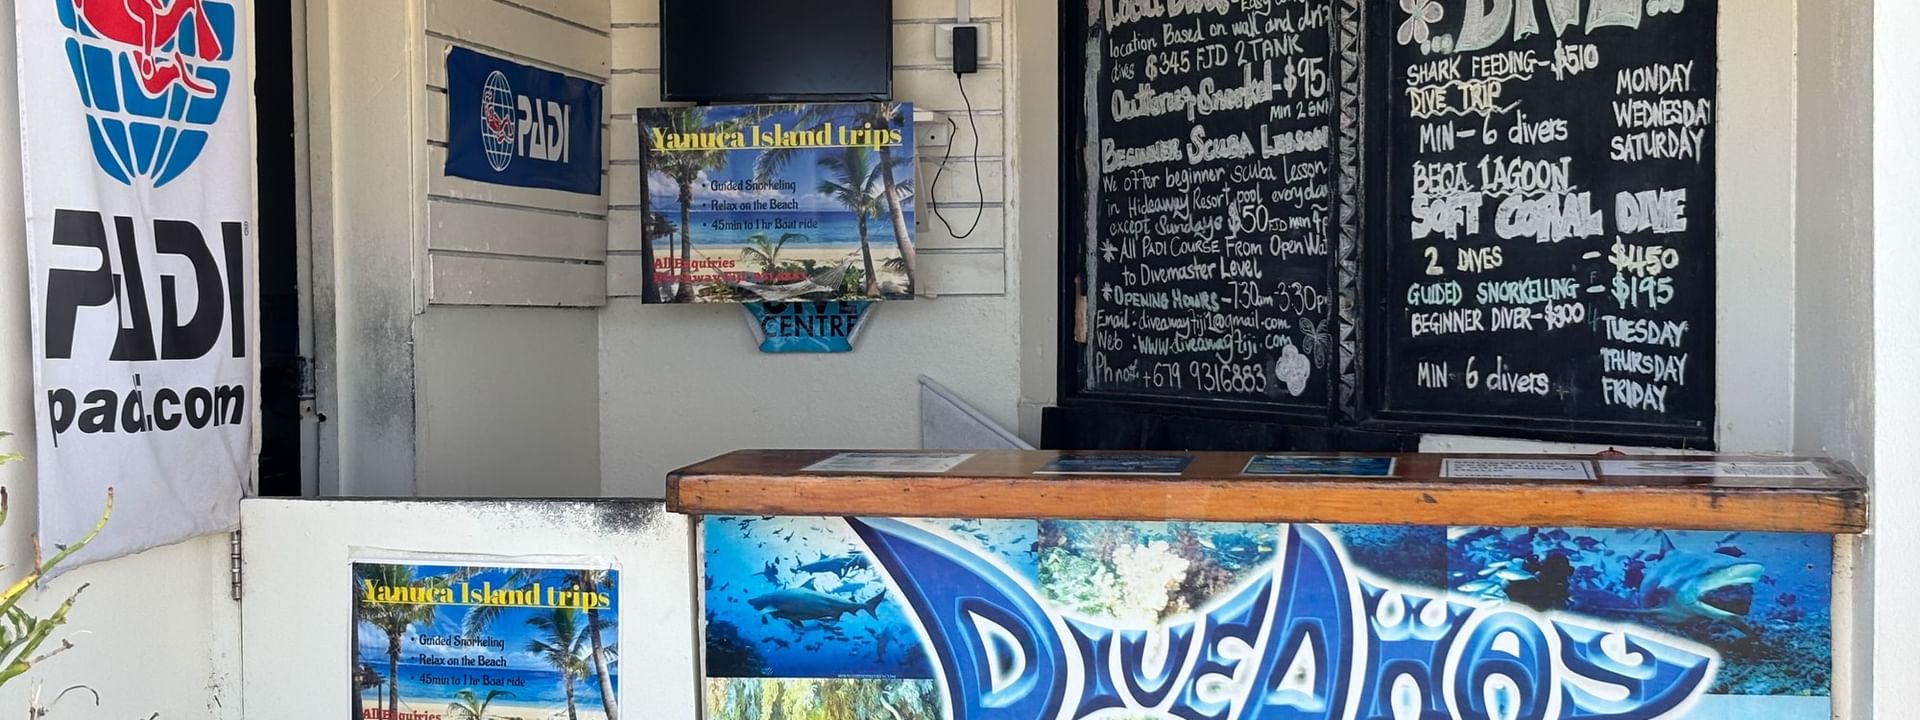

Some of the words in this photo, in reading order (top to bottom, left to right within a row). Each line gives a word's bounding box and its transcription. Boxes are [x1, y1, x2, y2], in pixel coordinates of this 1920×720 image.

[1110, 31, 1157, 58] location
[1163, 17, 1205, 46] Based
[1209, 22, 1228, 37] on
[1232, 10, 1261, 38] wall
[1265, 9, 1295, 33] and
[1111, 63, 1135, 83] dives
[1145, 50, 1190, 81] $345
[1196, 45, 1228, 71] FJD
[1235, 40, 1248, 67] 2
[1248, 33, 1304, 62] TANK
[1406, 55, 1461, 86] SHARK
[1616, 60, 1694, 95] MONDAY
[1296, 103, 1306, 120] 2
[1408, 89, 1447, 111] DIVE
[1457, 81, 1503, 110] TRIP
[1612, 98, 1711, 128] WEDNESDAY
[517, 94, 570, 163] PADI
[651, 126, 745, 153] Yanuca
[752, 122, 832, 148] Island
[839, 122, 903, 152] trips
[1483, 112, 1497, 145] 6
[1509, 109, 1568, 145] divers
[1611, 127, 1705, 164] SATURDAY
[710, 180, 744, 193] Guided
[745, 180, 797, 194] Snorkeling
[1103, 175, 1118, 193] We
[1123, 170, 1160, 191] offer
[1165, 166, 1225, 192] beginner
[1230, 159, 1277, 184] scuba
[1283, 156, 1328, 185] lesson
[1412, 160, 1475, 194] BEQA
[1477, 155, 1577, 193] LAGOON
[711, 199, 738, 212] Relax
[740, 202, 751, 211] on
[753, 199, 768, 211] the
[769, 198, 799, 211] Beach
[1107, 200, 1120, 217] in
[1128, 192, 1190, 220] Hideaway
[1193, 182, 1231, 210] Resort
[1236, 186, 1263, 214] pool
[1411, 190, 1483, 240] SOFT
[1495, 190, 1604, 243] CORAL
[1615, 188, 1687, 233] DIVE
[711, 219, 743, 231] 45min
[744, 221, 754, 231] to
[774, 218, 798, 231] Boat
[799, 218, 819, 230] ride
[1110, 214, 1151, 240] except
[1154, 213, 1224, 241] Sundays
[1227, 198, 1269, 239] $50
[1269, 218, 1288, 232] FJD
[675, 258, 736, 272] Equiries
[1120, 237, 1137, 261] All
[1269, 234, 1304, 260] Open
[1424, 246, 1444, 276] 2
[1457, 246, 1503, 273] DIVES
[1608, 236, 1680, 277] $450
[45, 208, 247, 361] PADI
[1122, 266, 1136, 287] to
[1140, 257, 1216, 286] Divemaster
[1220, 256, 1262, 279] Level
[1114, 286, 1169, 309] OPENING
[1171, 288, 1221, 312] HOURS
[1408, 282, 1462, 306] GUIDED
[1476, 277, 1580, 305] SNORKELLING
[1611, 271, 1674, 310] $195
[1411, 308, 1484, 337] BEGINNER
[1601, 315, 1688, 347] TUESDAY
[1096, 351, 1112, 383] Ph
[1189, 360, 1267, 391] 9316883
[1466, 356, 1479, 391] 6
[1487, 355, 1550, 396] divers
[1600, 347, 1688, 386] THURSDAY
[1601, 377, 1668, 413] FRIDAY
[362, 578, 455, 606] Yanuca
[461, 581, 541, 606] Island
[547, 584, 611, 613] trips
[419, 634, 452, 647] Guided
[454, 635, 505, 650] Snorkeling
[419, 654, 447, 666] Relax
[448, 657, 460, 666] on
[461, 655, 476, 666] the
[478, 656, 507, 668] Beach
[419, 674, 450, 685] 45min
[451, 676, 461, 686] to
[482, 675, 505, 687] Boat
[507, 676, 526, 688] ride
[382, 708, 442, 720] Equiries
